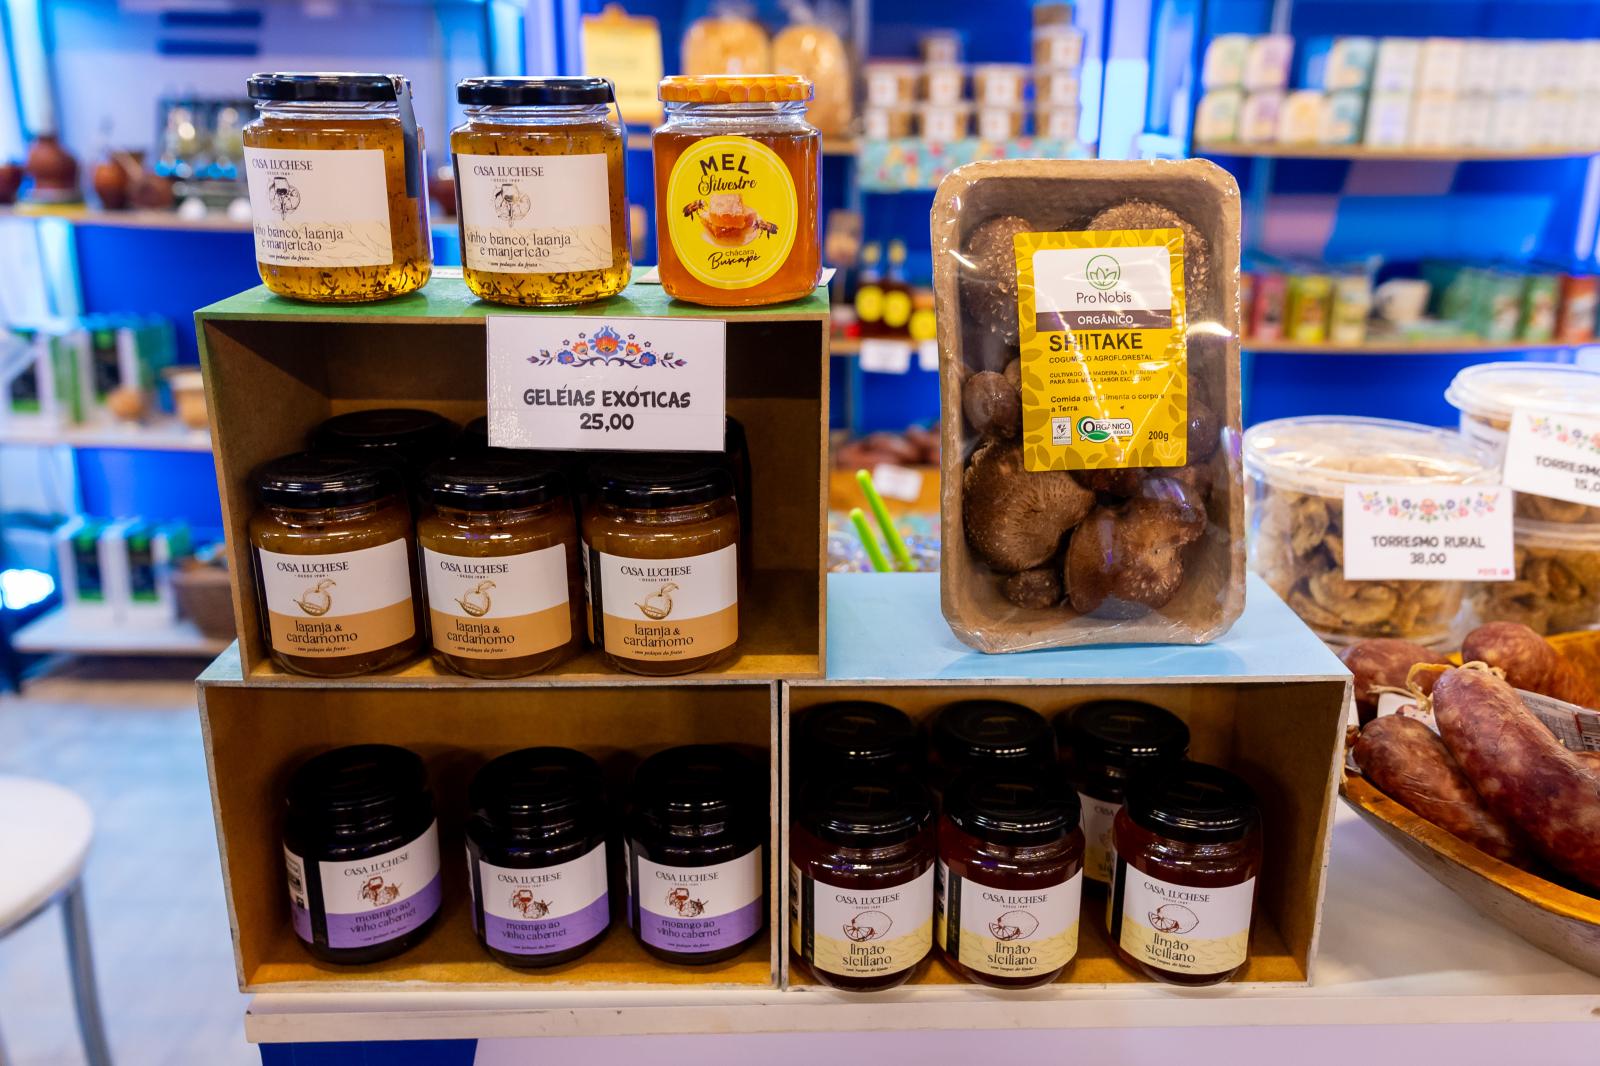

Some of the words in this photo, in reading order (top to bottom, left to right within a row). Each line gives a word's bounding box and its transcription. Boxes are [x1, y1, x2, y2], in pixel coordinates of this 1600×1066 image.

[252, 159, 268, 170] CASA
[270, 160, 313, 171] LUCHESE
[474, 165, 495, 176] CASA
[498, 166, 545, 177] LUCHESE
[699, 153, 750, 176] MEL
[698, 174, 756, 196] Silvestre
[268, 225, 301, 240] branco,
[305, 226, 344, 242] laranja
[467, 231, 487, 244] vinho
[489, 232, 529, 246] branco,
[533, 233, 571, 249] laranja
[266, 240, 322, 255] manjericão
[480, 248, 485, 256] e
[488, 246, 550, 261] manjericão
[725, 249, 755, 257] chácara
[1076, 292, 1095, 304] Pro
[1099, 291, 1132, 304] Nobis
[1077, 313, 1134, 326] ORGÂNICO
[1049, 332, 1143, 352] SHIITAKE
[1049, 355, 1092, 364] COGUMO
[523, 384, 596, 406] GELÉIAS
[602, 385, 691, 408] EXÓTICAS
[1050, 395, 1081, 403] Comida
[1099, 393, 1129, 401] limenta
[580, 412, 634, 432] 25,00
[1148, 430, 1169, 441] 200g
[1372, 535, 1439, 548] TORRESMO
[1445, 535, 1485, 548] RURAL
[1410, 553, 1446, 565] 38,00
[277, 561, 299, 572] CASA
[302, 561, 349, 573] LUCHESE
[440, 561, 461, 573] CASA
[464, 563, 509, 574] LUCHESE
[620, 565, 644, 576] CASA
[647, 565, 692, 577] LUCHESE
[295, 620, 332, 635] laranja
[334, 624, 343, 632] &
[456, 619, 490, 635] laranja
[634, 624, 671, 639] laranja
[286, 631, 358, 644] cardamomo
[447, 630, 515, 645] cardamomo
[623, 636, 694, 648] cardamomo
[344, 866, 368, 877] CASA
[371, 853, 409, 872] LUCHESE
[497, 873, 519, 884] CASA
[521, 872, 562, 884] LUCHESE
[655, 871, 677, 882] CASA
[679, 871, 720, 882] LUCHESE
[835, 894, 858, 905] CASA
[861, 892, 901, 905] LUCHESE
[982, 892, 1005, 903] CASA
[1008, 893, 1049, 904] LUCHESE
[1144, 881, 1166, 896] CASA
[1168, 889, 1210, 903] LUCHESE
[355, 907, 398, 925] morango
[399, 901, 411, 912] ao
[350, 921, 377, 934] vinho
[506, 922, 547, 932] morango
[548, 920, 560, 930] ao
[662, 919, 702, 930] morango
[703, 919, 715, 928] ao
[502, 929, 526, 941] vinho
[526, 928, 567, 941] cabernet
[656, 926, 681, 939] vinho
[681, 928, 721, 939] cabernet
[995, 941, 1031, 954] limão
[1153, 932, 1189, 951] limão
[850, 943, 885, 956] limão
[1145, 943, 1196, 963] siciliano
[842, 954, 892, 967] siciliano
[987, 952, 1037, 965] siciliano
